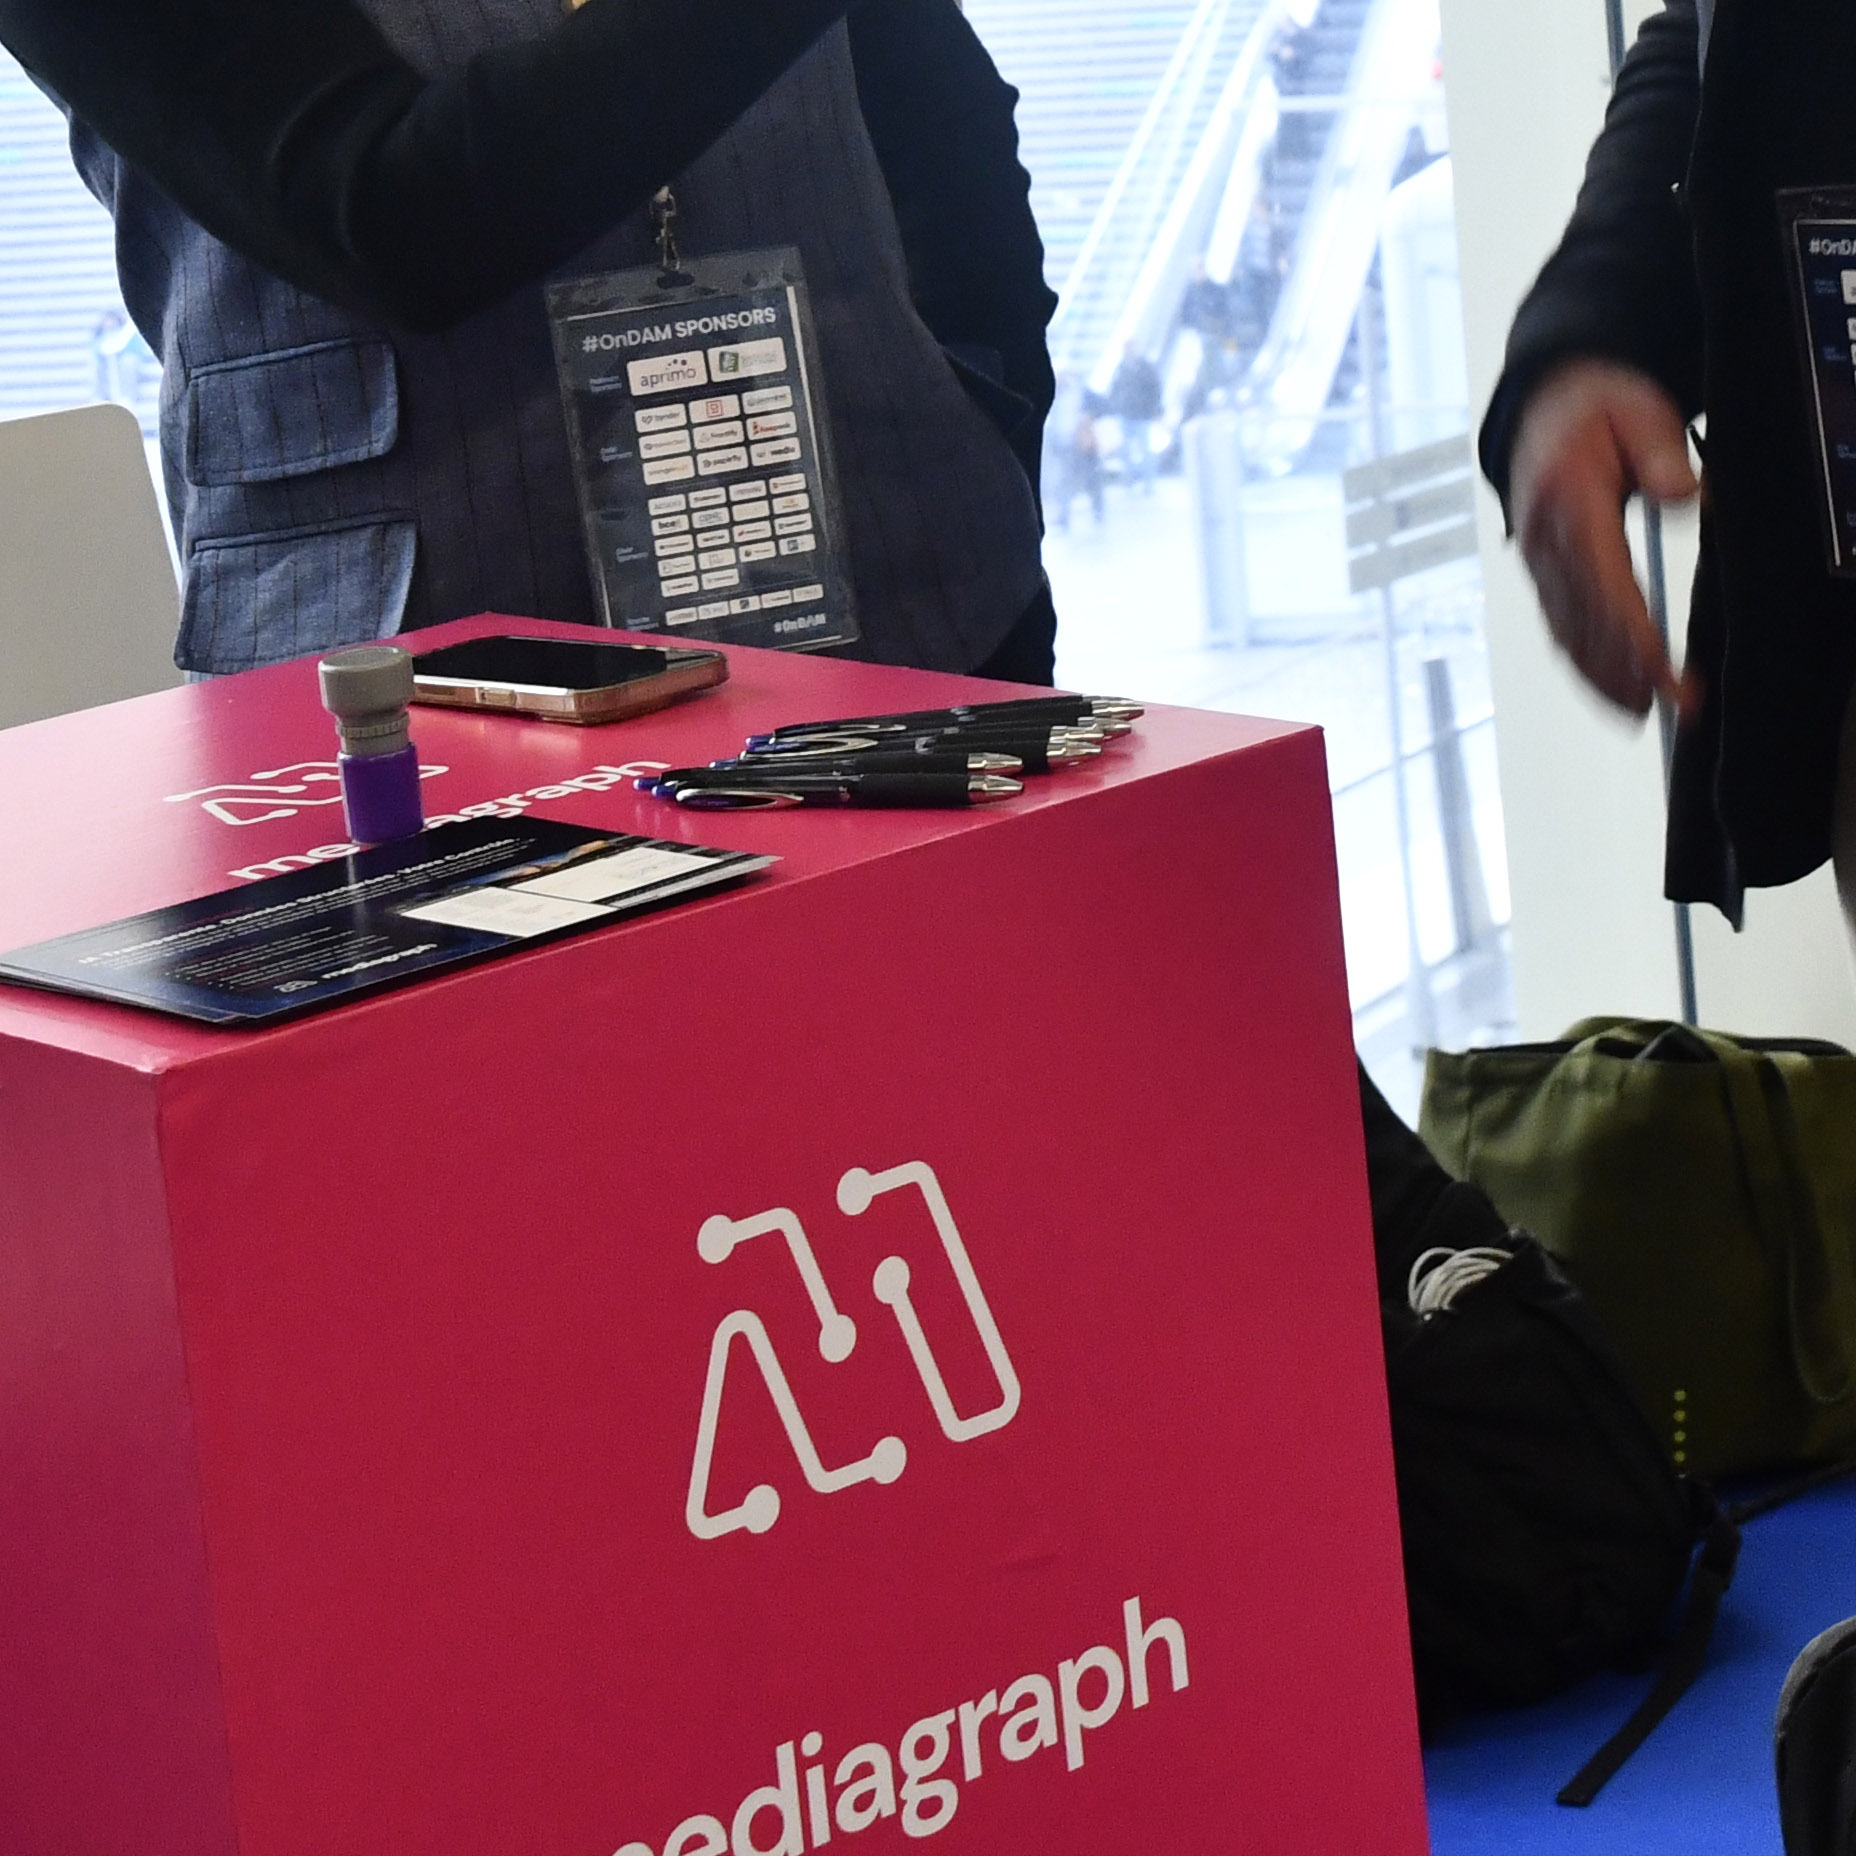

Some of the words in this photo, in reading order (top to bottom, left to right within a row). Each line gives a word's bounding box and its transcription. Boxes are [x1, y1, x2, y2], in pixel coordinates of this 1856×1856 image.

[581, 322, 673, 353] #OnDAM
[674, 306, 777, 339] SPONSORS
[640, 366, 697, 389] aprimo
[227, 757, 671, 882] meagraph
